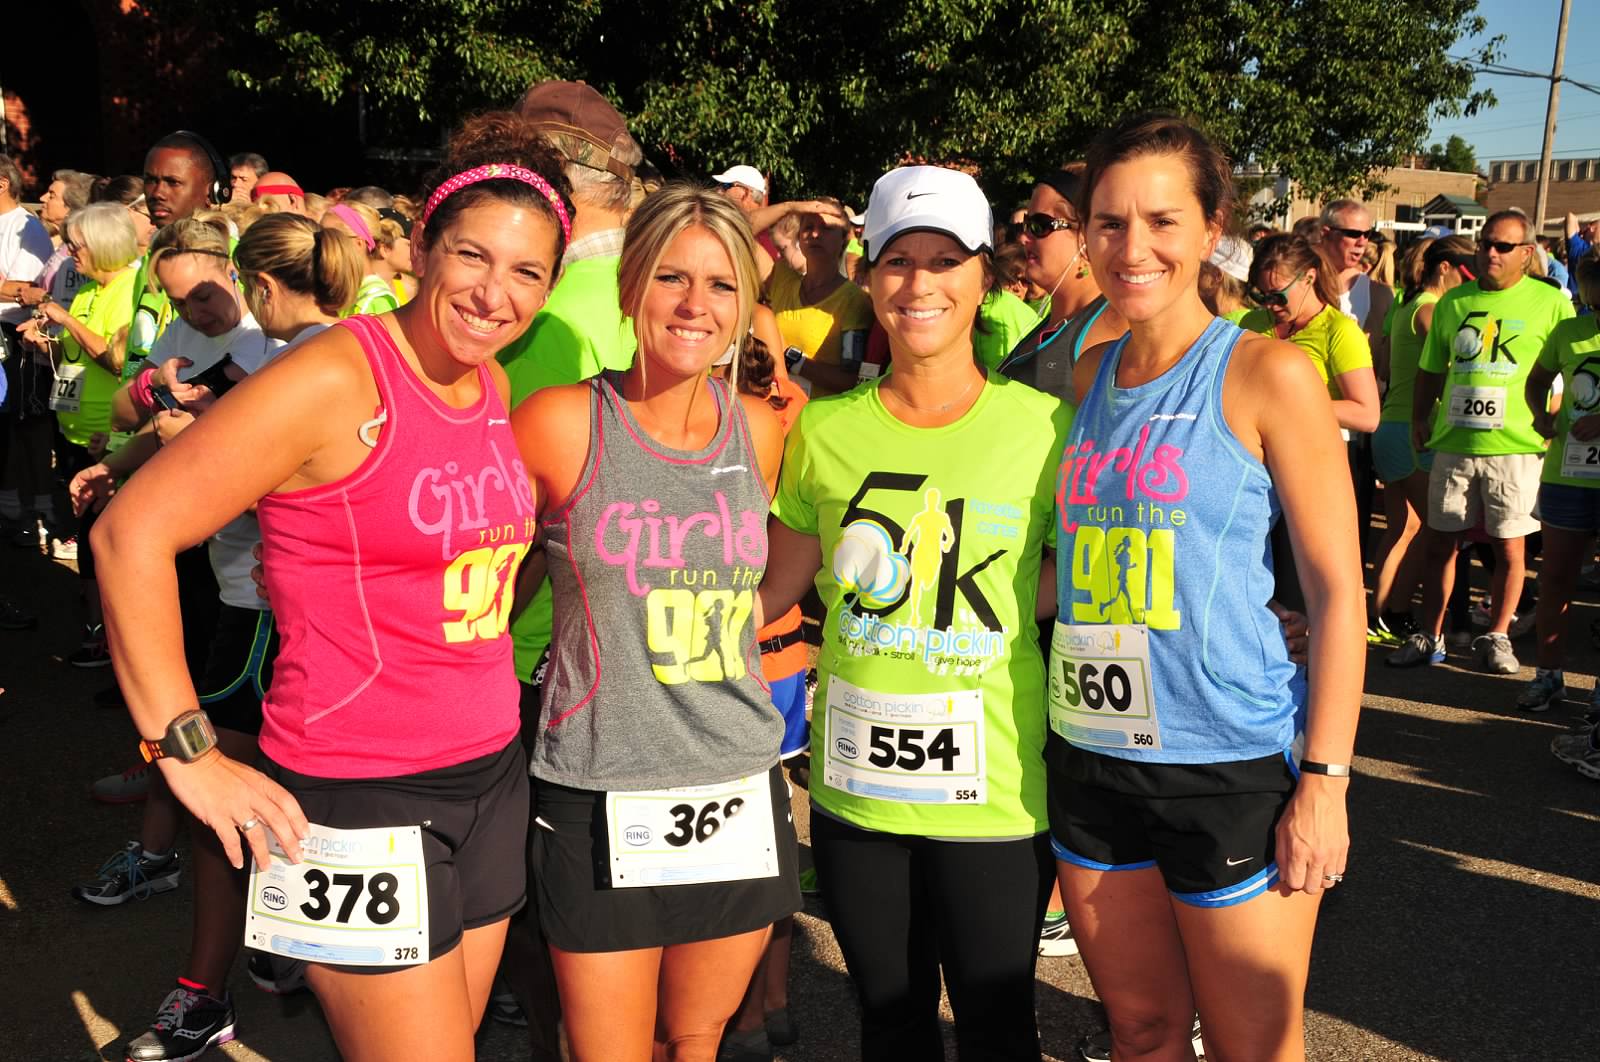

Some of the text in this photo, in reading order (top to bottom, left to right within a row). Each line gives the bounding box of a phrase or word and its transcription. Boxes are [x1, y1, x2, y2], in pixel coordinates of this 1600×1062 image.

[1463, 399, 1496, 416] 206
[408, 439, 536, 561] Girls
[1087, 501, 1187, 526] run the
[479, 519, 536, 544] run th
[594, 489, 769, 598] Girls
[669, 566, 763, 586] run the
[1071, 525, 1181, 631] 901
[442, 541, 532, 644] 90
[646, 588, 753, 685] 901
[839, 610, 917, 649] cotton
[1062, 660, 1132, 712] 560
[842, 690, 882, 710] cotton
[837, 740, 858, 756] RING
[868, 726, 961, 772] 554
[1133, 733, 1153, 746] 560
[955, 790, 978, 800] 554
[625, 831, 651, 841] RING
[262, 890, 286, 906] RING
[299, 868, 401, 926] 378
[394, 947, 419, 961] 378
